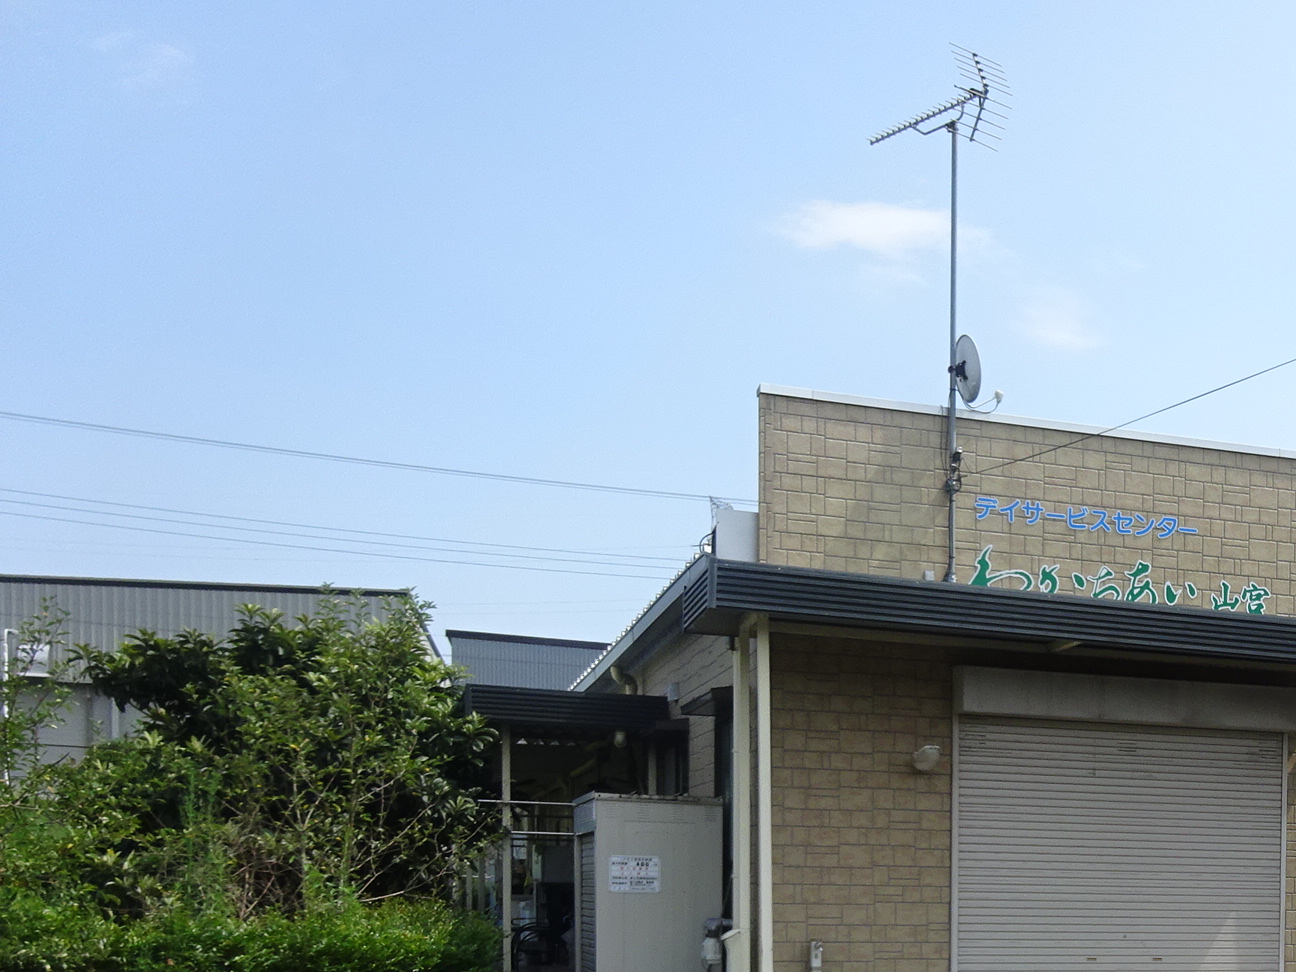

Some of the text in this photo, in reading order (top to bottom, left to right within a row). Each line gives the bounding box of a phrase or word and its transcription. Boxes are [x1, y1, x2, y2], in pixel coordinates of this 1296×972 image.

[974, 497, 1198, 538] デイサービスセンター
[1212, 581, 1270, 614] 山宮
